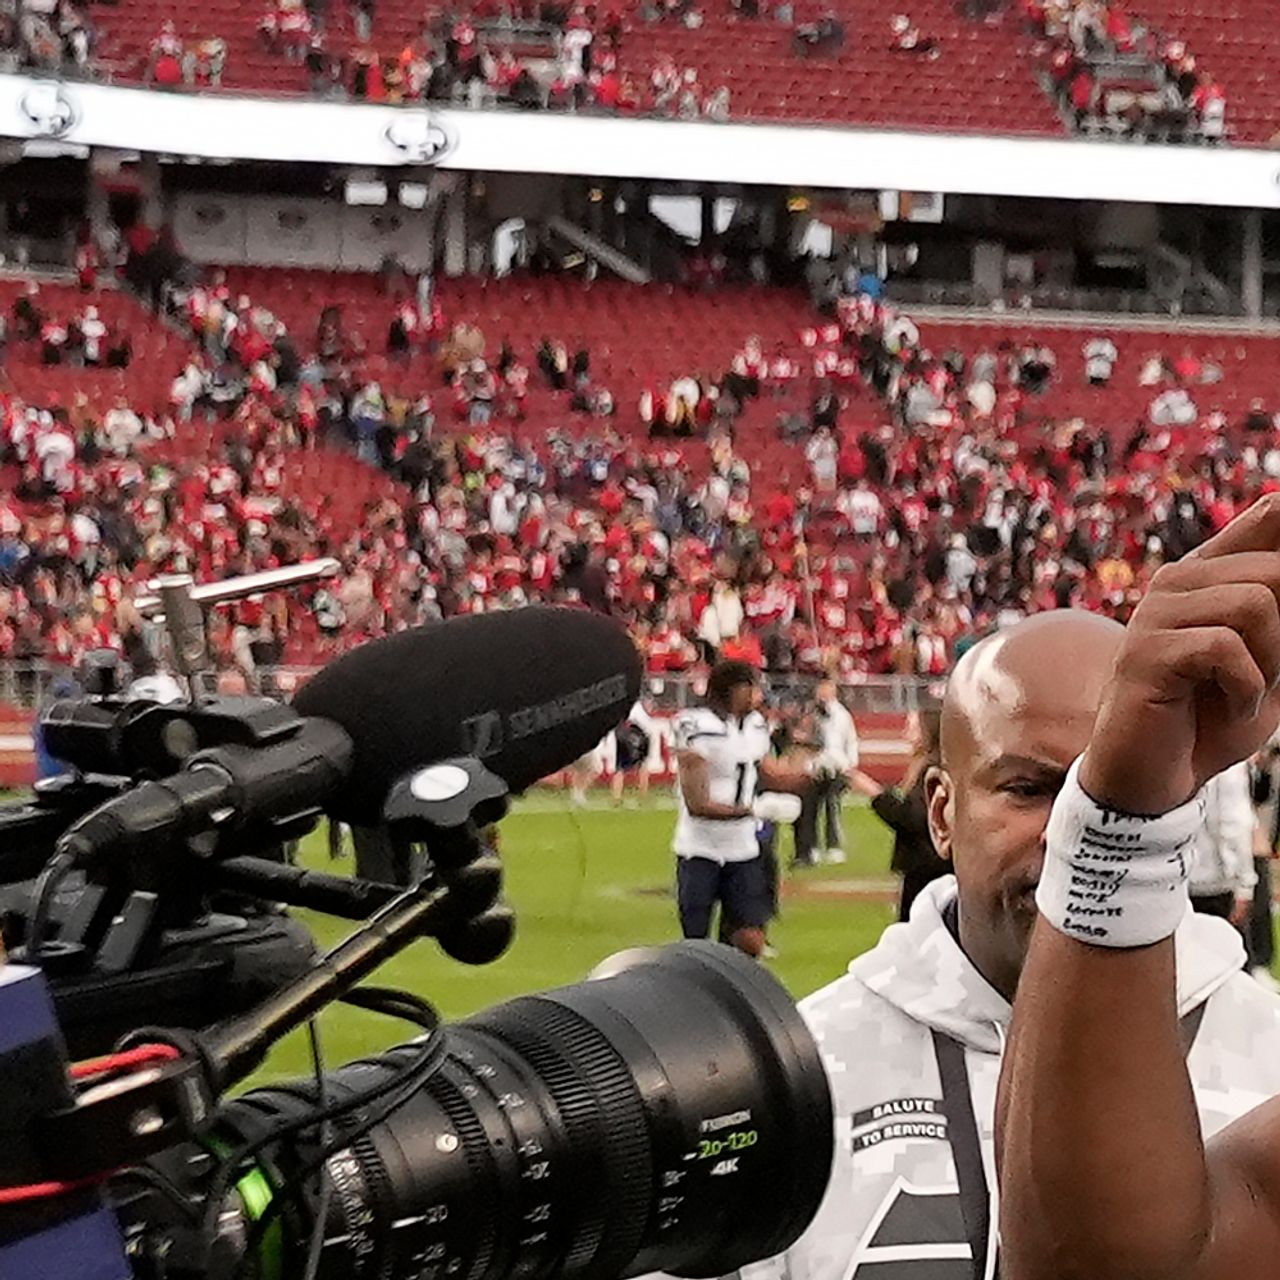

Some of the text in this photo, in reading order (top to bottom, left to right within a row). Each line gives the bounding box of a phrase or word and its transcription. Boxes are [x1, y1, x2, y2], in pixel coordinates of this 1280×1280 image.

[872, 1099, 936, 1119] SALUTE
[698, 1130, 759, 1160] 20-120
[861, 1123, 946, 1147] TO SERVICE
[710, 1156, 741, 1176] 4K
